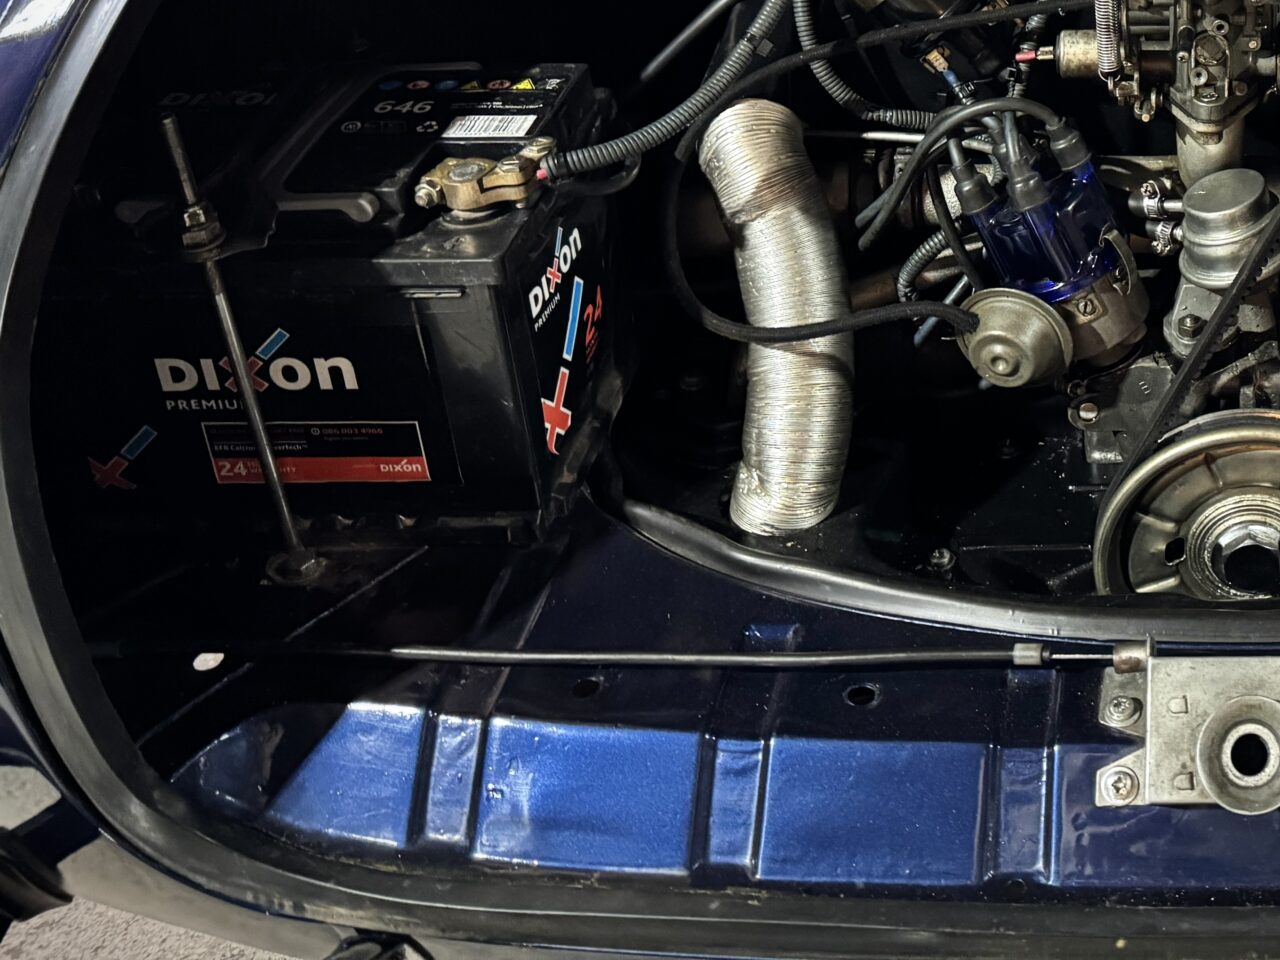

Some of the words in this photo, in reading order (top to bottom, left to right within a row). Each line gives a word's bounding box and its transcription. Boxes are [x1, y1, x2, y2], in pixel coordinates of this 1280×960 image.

[374, 100, 434, 114] 646
[534, 293, 560, 332] PREMIUM
[584, 284, 602, 347] 24
[165, 399, 244, 410] PREMIU
[218, 461, 248, 476] 24
